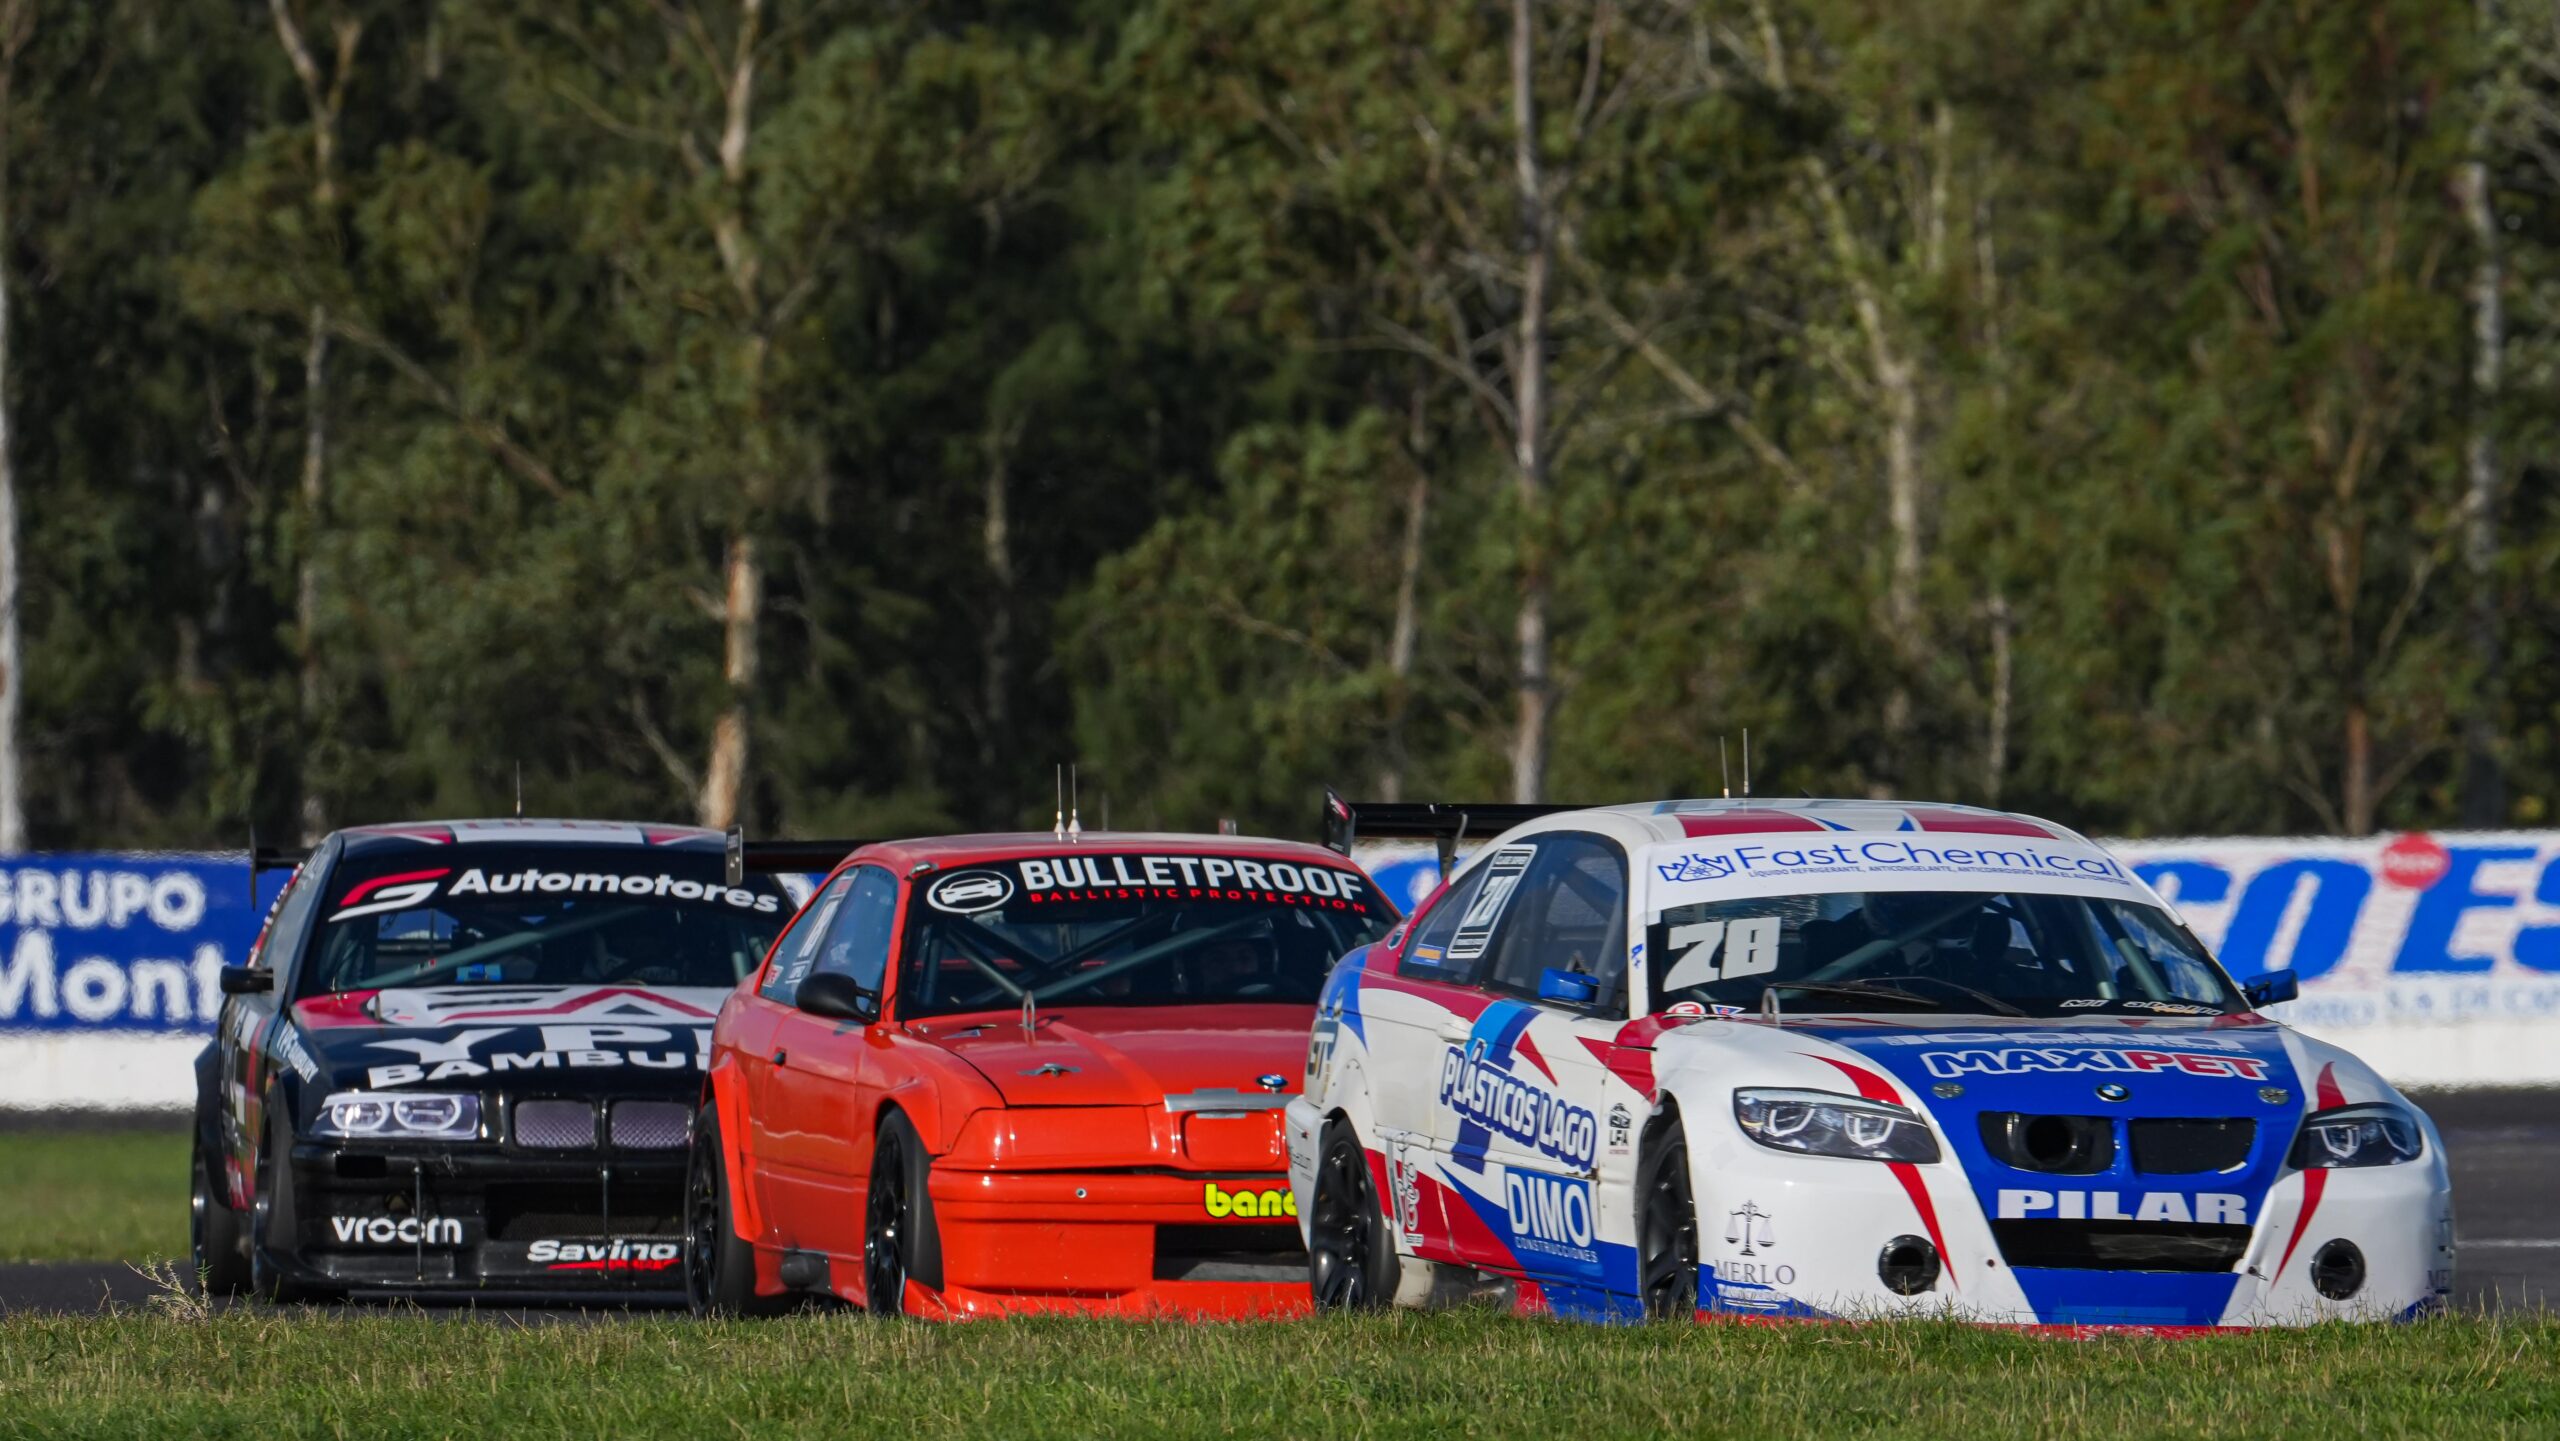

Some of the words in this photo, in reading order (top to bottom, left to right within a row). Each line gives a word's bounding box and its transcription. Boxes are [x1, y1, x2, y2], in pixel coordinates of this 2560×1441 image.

[448, 867, 779, 913] Automotores
[1018, 856, 1363, 900] BULLETPROOF
[0, 868, 206, 932] RUPO
[1030, 887, 1180, 903] BALLISTIC
[1189, 888, 1367, 913] PROTECTION
[363, 1024, 712, 1064] YP
[368, 1050, 711, 1090] BAMBU
[1921, 1049, 2270, 1080] MAXIPET
[1440, 1043, 1539, 1140] PLÁSTICOS
[1538, 1095, 1596, 1164] LAGO
[1506, 1172, 1592, 1248] DIMO
[1997, 1189, 2248, 1225] PILAR
[331, 1216, 463, 1244] vroom
[527, 1239, 679, 1262] Savino
[1514, 1236, 1599, 1263] CONSTRUCCIONES
[1714, 1259, 1796, 1285] MERLO
